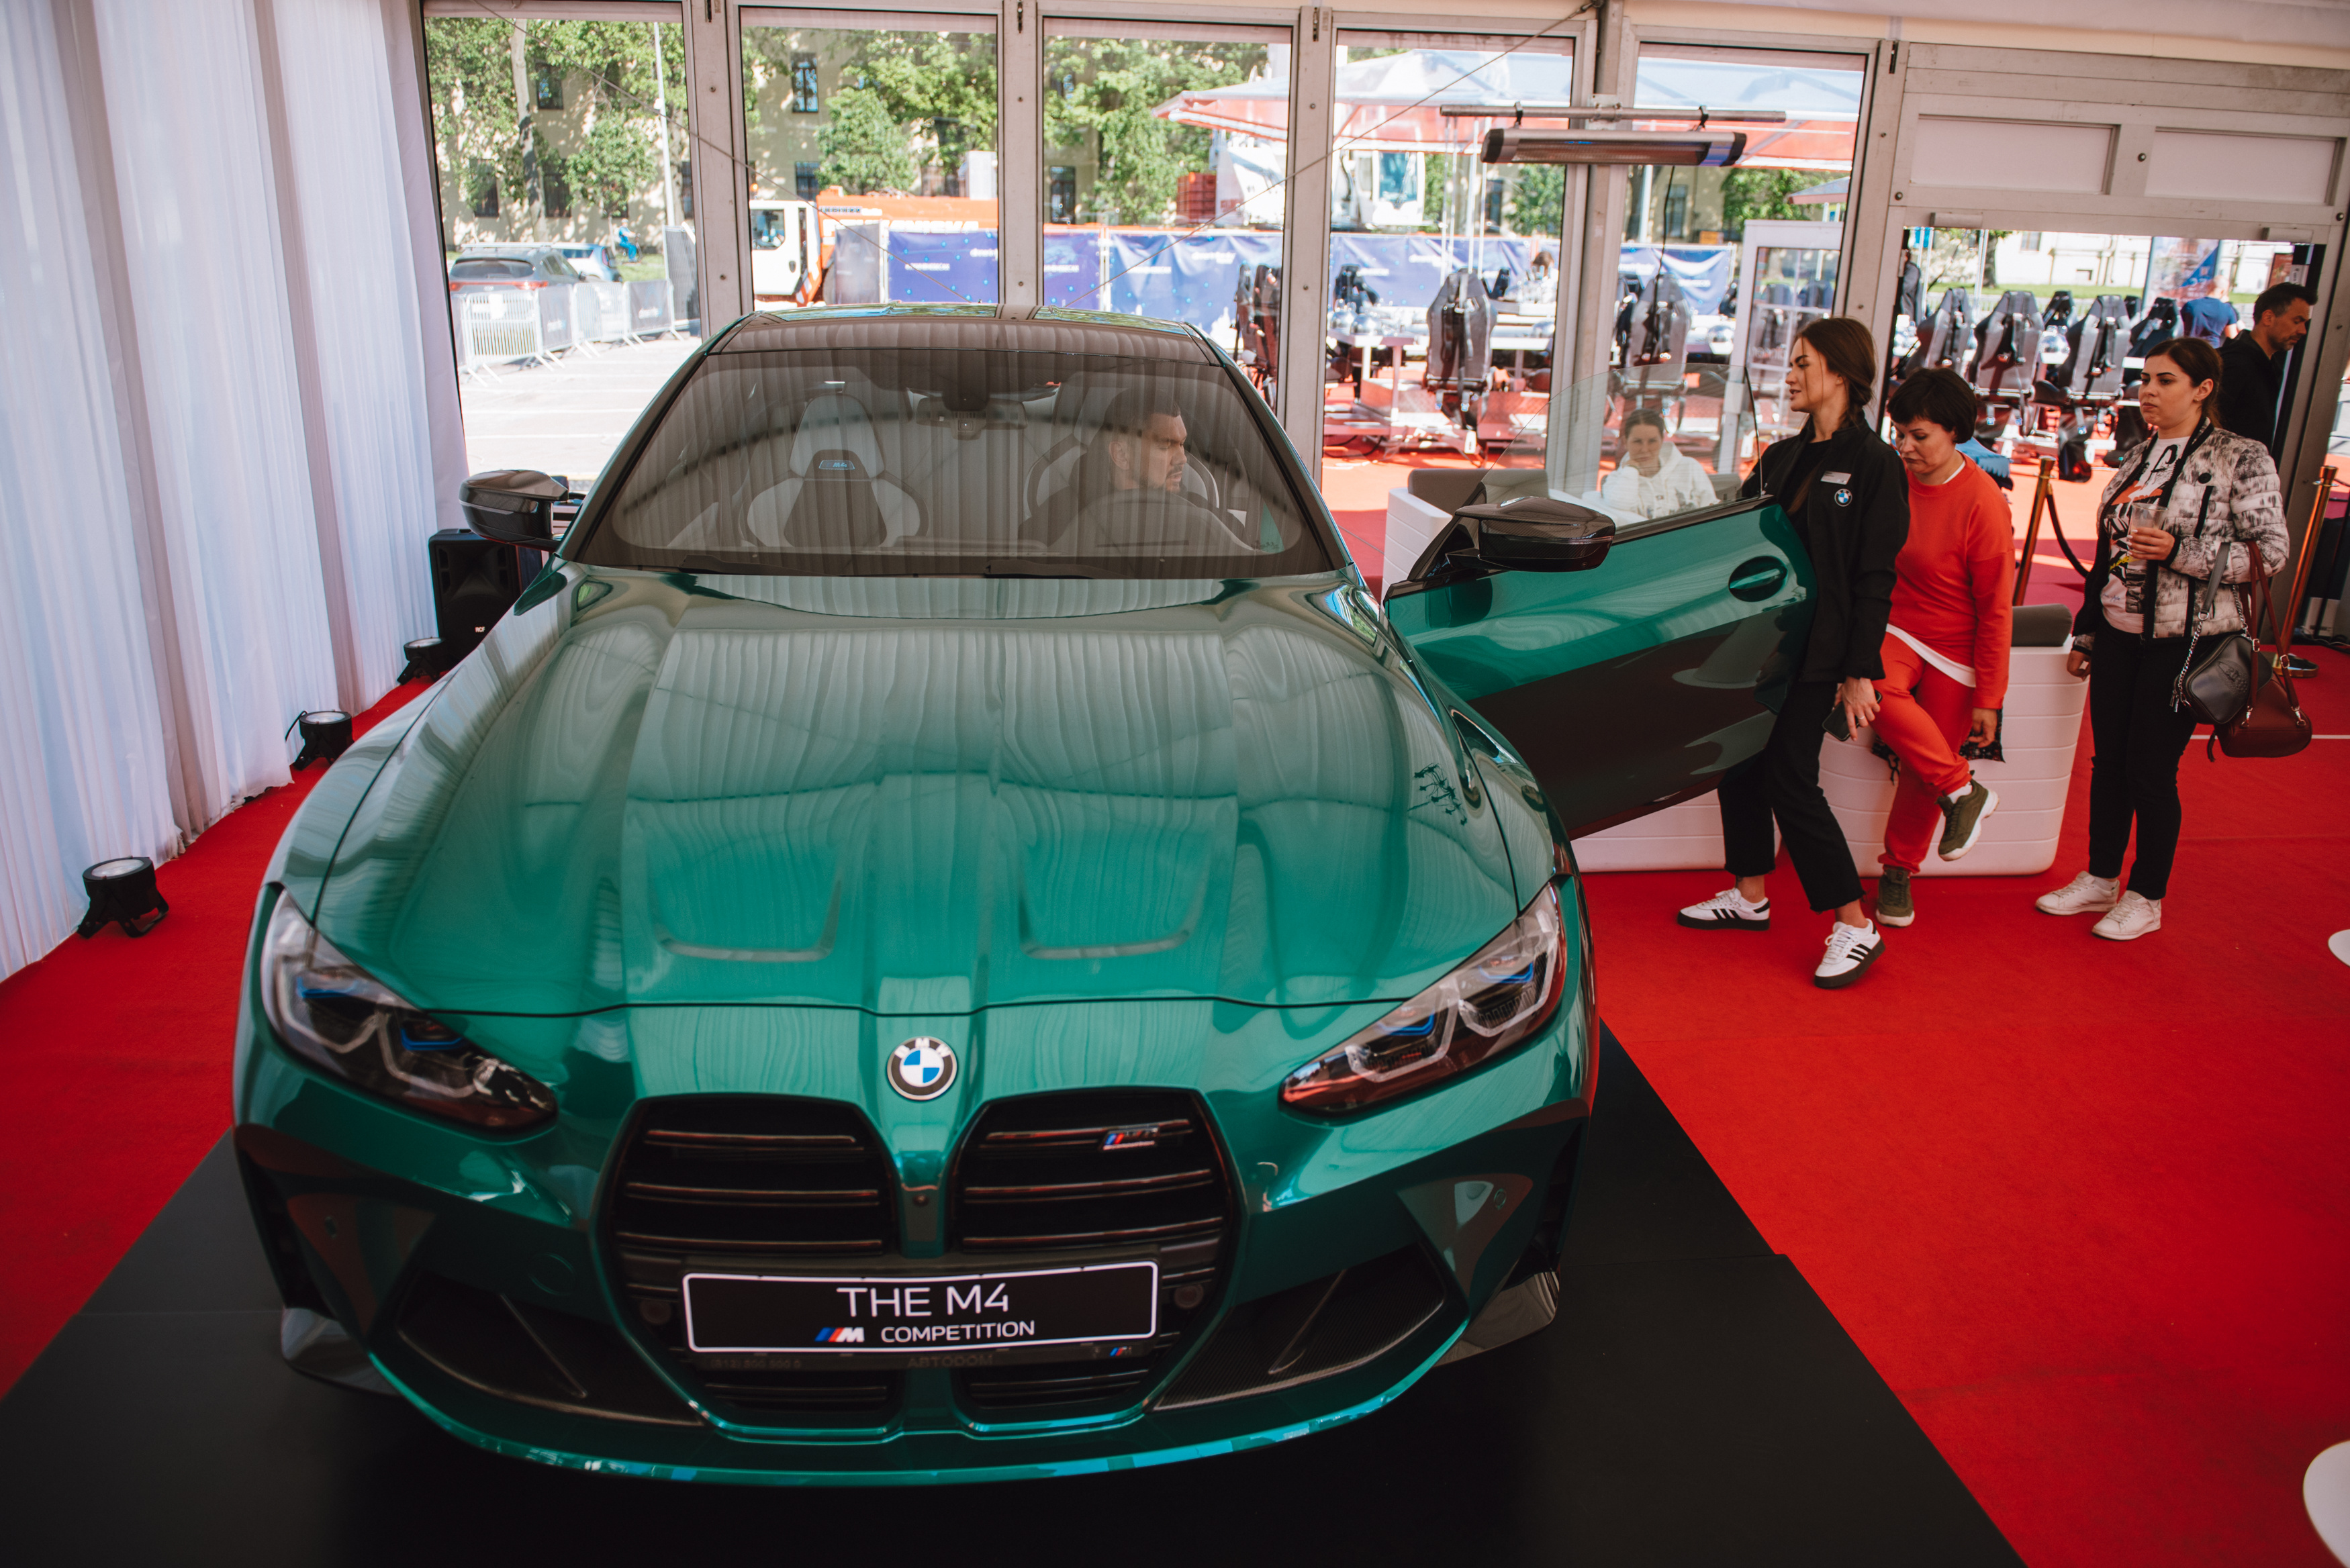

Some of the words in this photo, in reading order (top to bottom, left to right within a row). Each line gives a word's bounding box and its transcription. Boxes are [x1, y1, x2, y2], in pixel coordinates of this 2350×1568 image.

[894, 1037, 951, 1059] BMW
[837, 1287, 932, 1317] THE
[947, 1283, 1008, 1316] M4
[881, 1320, 1035, 1342] COMPETITION
